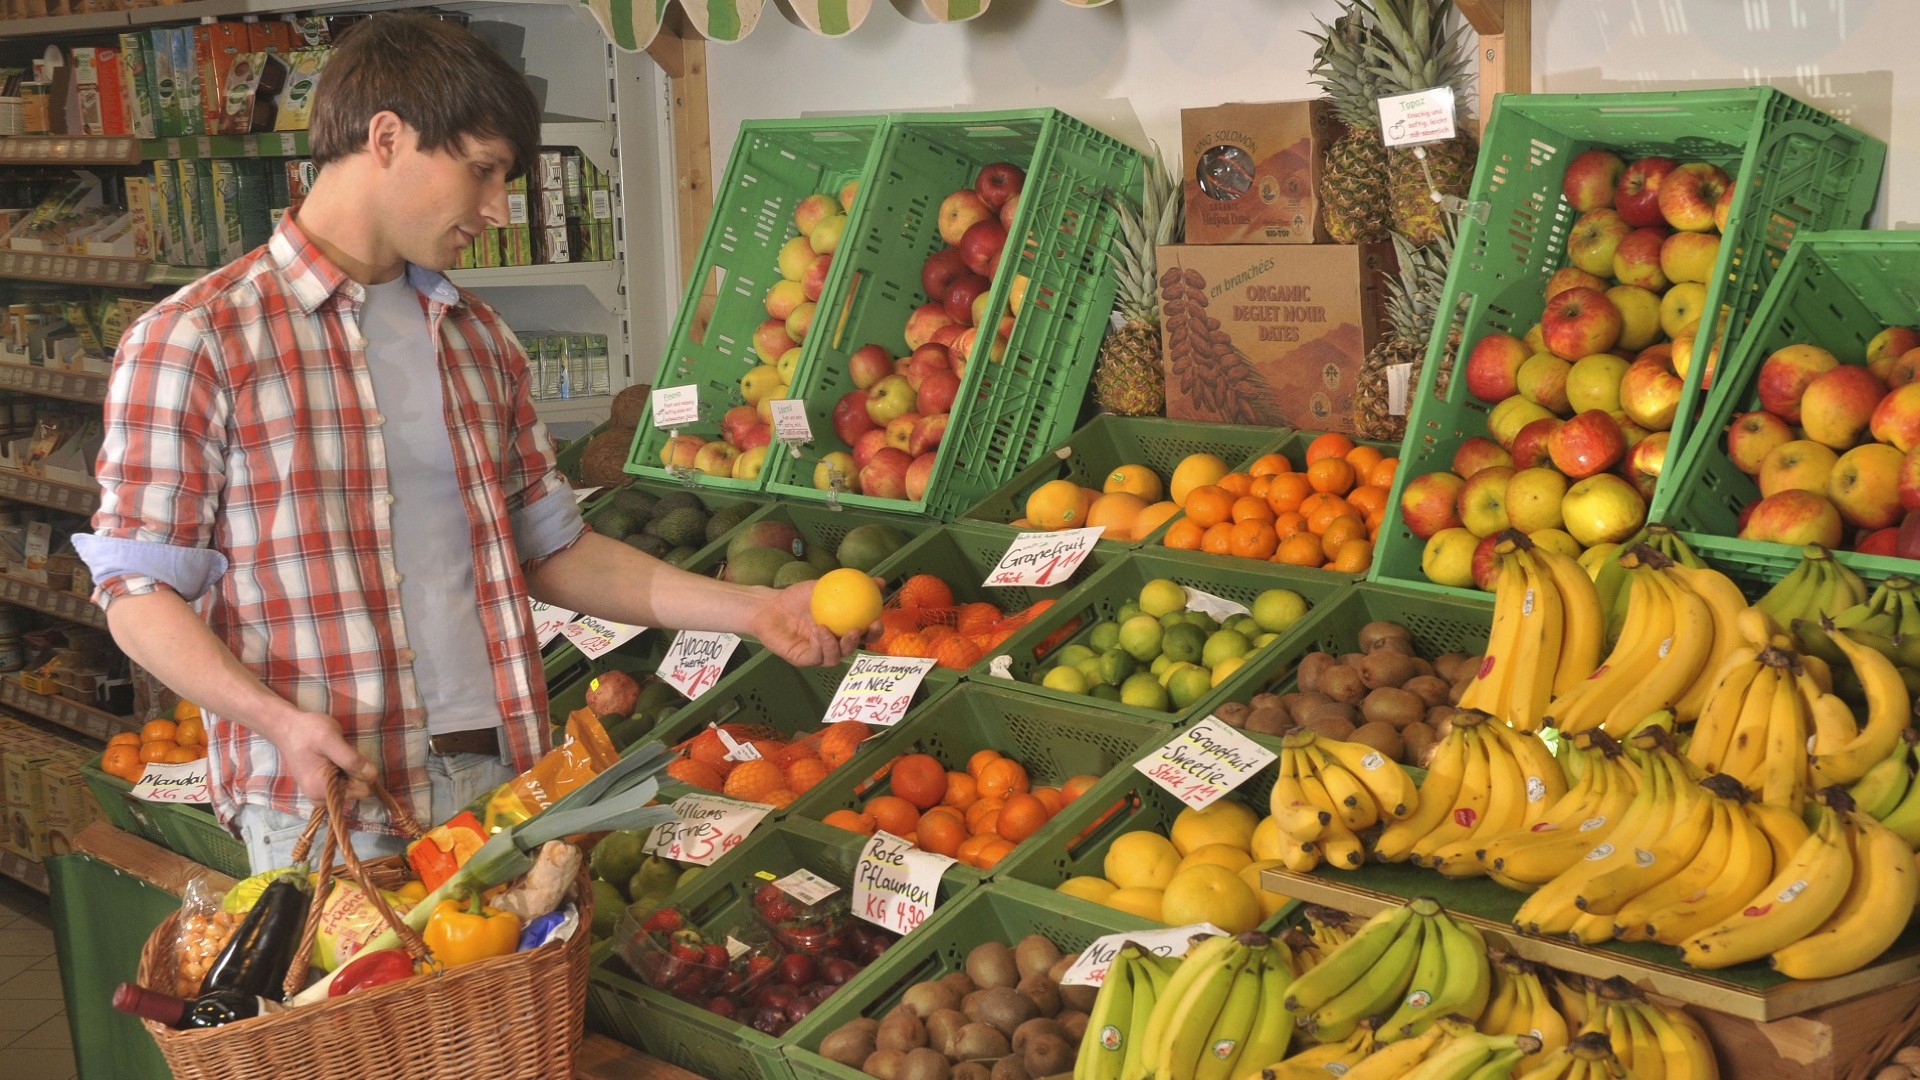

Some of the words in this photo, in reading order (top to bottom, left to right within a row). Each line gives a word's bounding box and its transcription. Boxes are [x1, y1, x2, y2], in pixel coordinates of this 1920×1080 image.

[1400, 98, 1425, 110] Topaz
[1215, 130, 1258, 154] SOLOMON
[1210, 285, 1223, 298] en
[1224, 257, 1275, 291] branchées
[1246, 285, 1311, 302] ORGANIC
[1233, 305, 1281, 322] DEGLET
[1283, 305, 1327, 322] NOUR
[1259, 325, 1300, 342] DATES
[1000, 536, 1086, 569] Grapefruit
[991, 571, 1024, 584] Stück
[669, 630, 722, 660] Avocado
[849, 659, 923, 680] Blutorangen
[843, 677, 863, 692] im
[864, 676, 894, 692] Netz
[1188, 726, 1260, 773] Grapefruit
[1148, 763, 1187, 788] Stück
[147, 788, 181, 799] KG
[184, 784, 208, 802] 2
[656, 821, 711, 847] Birne
[869, 838, 904, 866] Rote
[860, 860, 929, 908] Pflaumen
[866, 893, 886, 924] KG
